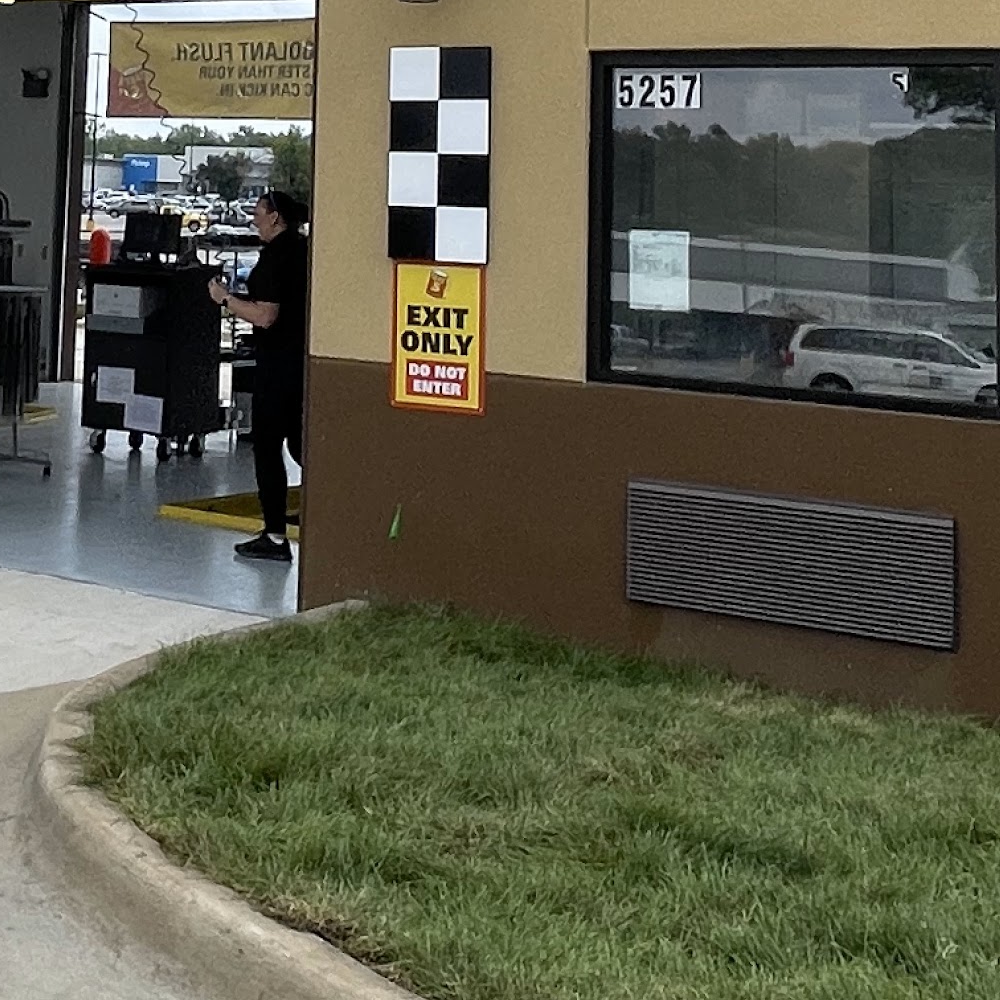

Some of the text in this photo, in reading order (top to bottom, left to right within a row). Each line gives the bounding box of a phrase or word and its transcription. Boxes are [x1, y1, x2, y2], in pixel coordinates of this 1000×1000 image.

[618, 74, 697, 107] 5257
[407, 304, 469, 329] EXIT
[401, 330, 474, 356] ONLY
[408, 362, 466, 380] DO NOT
[412, 379, 461, 396] ENTER
